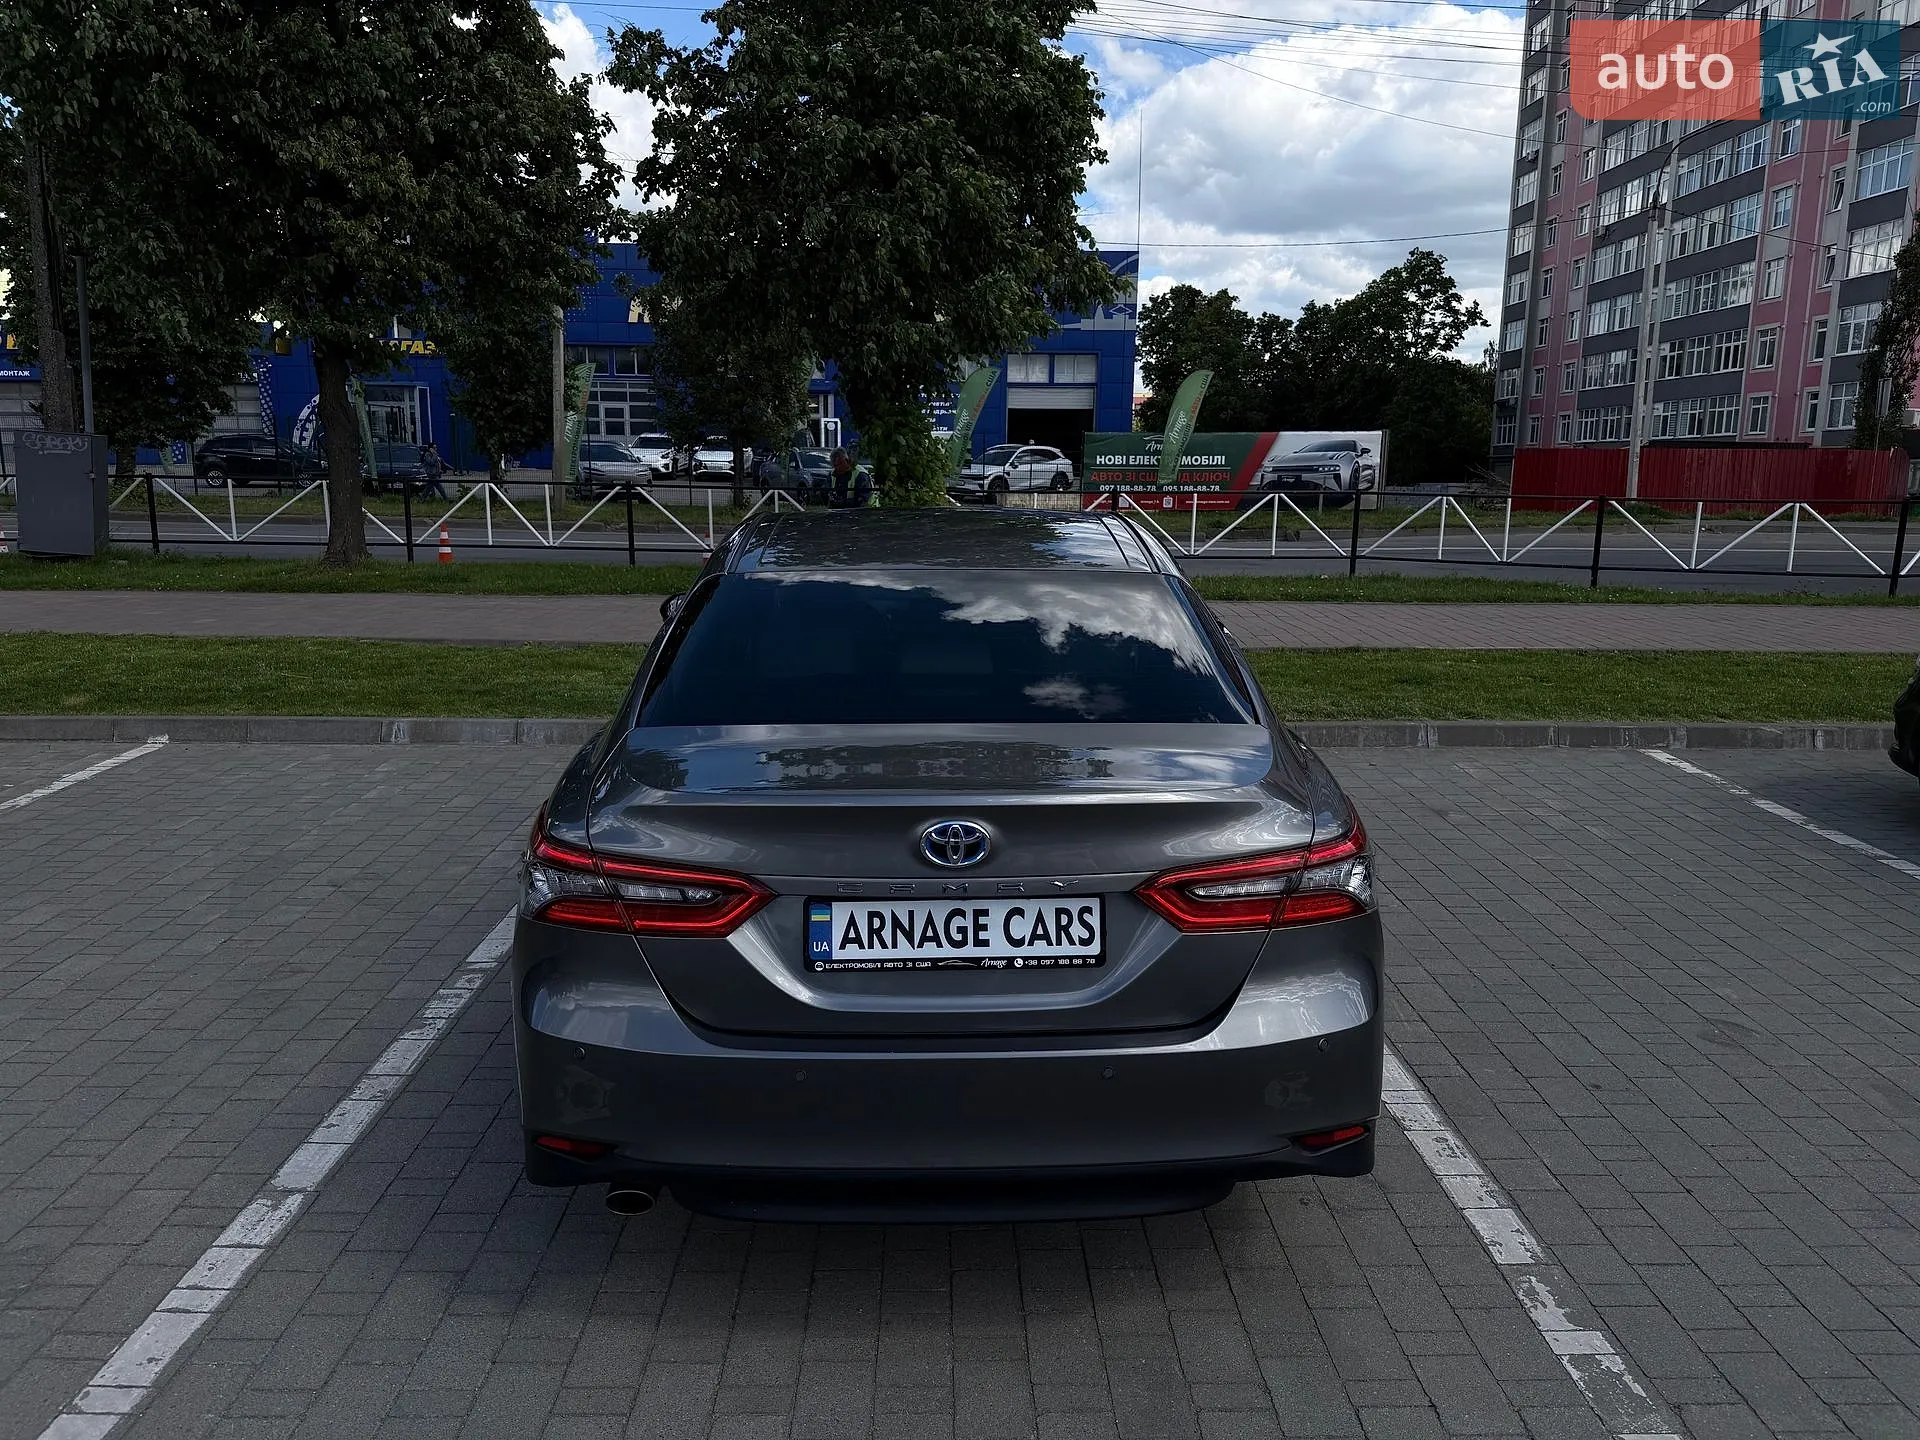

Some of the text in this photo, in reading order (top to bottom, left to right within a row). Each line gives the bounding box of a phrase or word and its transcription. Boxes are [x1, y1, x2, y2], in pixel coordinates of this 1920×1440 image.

[1096, 455, 1226, 465] НОВІ ЕЛЕКМОБІЛІ
[1091, 471, 1122, 483] АВТО
[1138, 471, 1159, 483] СШ
[1193, 471, 1231, 483] КЛЮЧ
[837, 879, 1079, 895] CAMRY
[838, 905, 1096, 951] ARNAGE CARS
[813, 941, 830, 952] UA
[980, 957, 1008, 969] Arnage
[1025, 959, 1038, 967] +38
